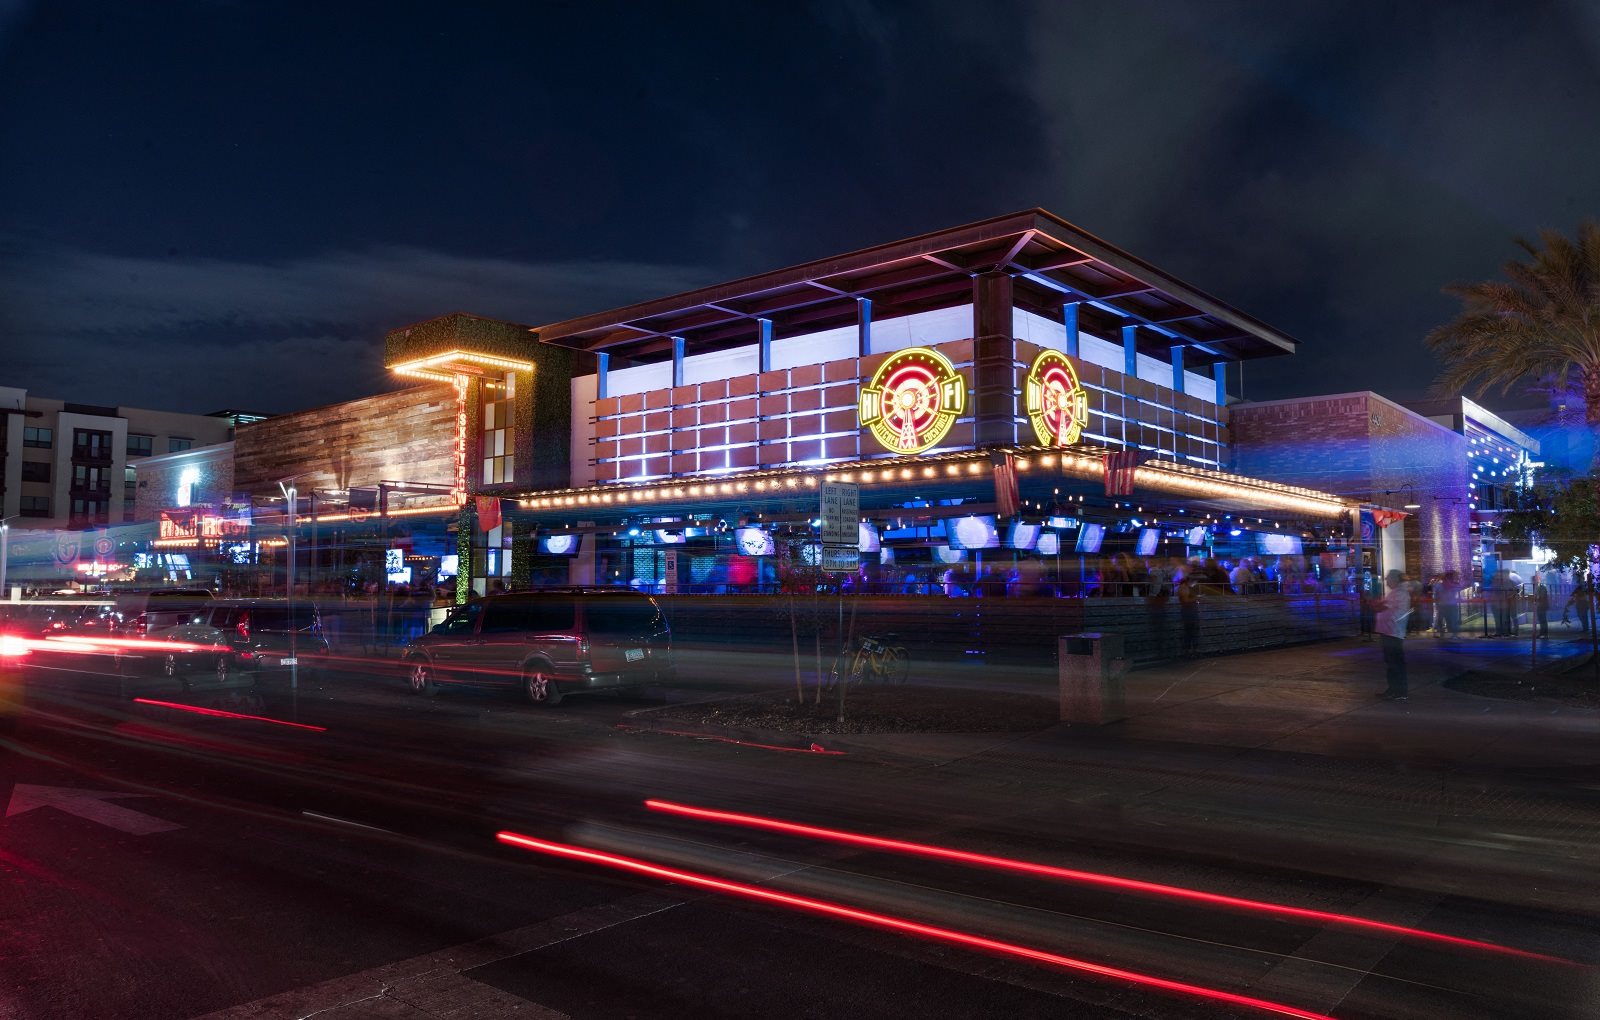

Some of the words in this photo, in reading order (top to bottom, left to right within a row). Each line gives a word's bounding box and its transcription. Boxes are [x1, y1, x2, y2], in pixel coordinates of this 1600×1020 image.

[862, 393, 878, 421] HI
[944, 381, 961, 410] FI
[875, 422, 900, 446] KITCHEN
[825, 487, 836, 495] LEFT
[842, 489, 856, 497] RIGHT
[824, 497, 838, 505] LANE
[843, 498, 856, 506] LANE
[837, 560, 845, 568] TO
